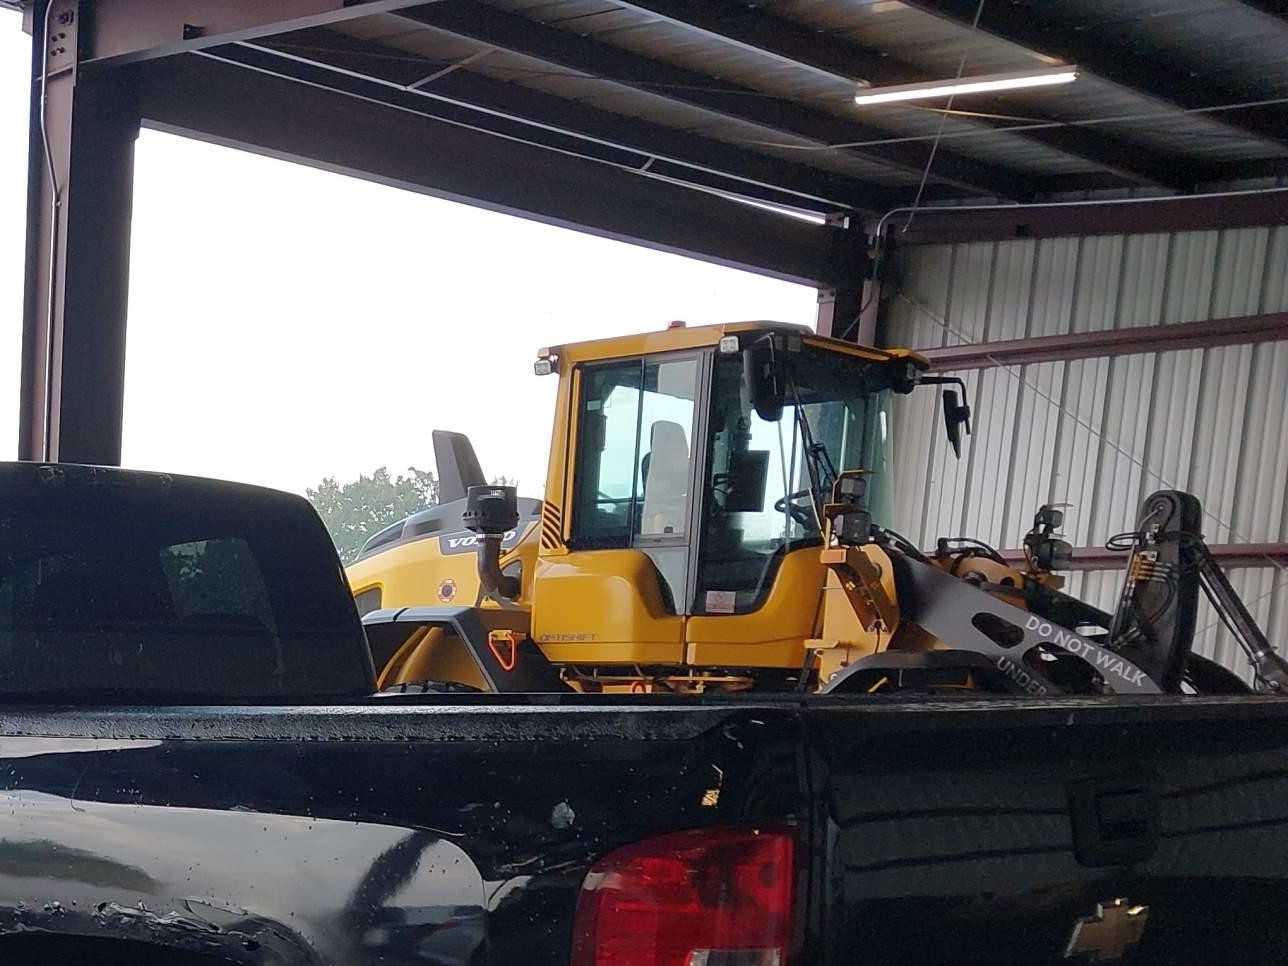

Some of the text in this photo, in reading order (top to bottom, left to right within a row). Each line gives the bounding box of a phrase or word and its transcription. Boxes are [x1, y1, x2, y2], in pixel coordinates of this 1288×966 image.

[448, 531, 516, 548] VOO
[1025, 615, 1149, 687] DO NOT WALK
[996, 656, 1047, 696] UNDER
